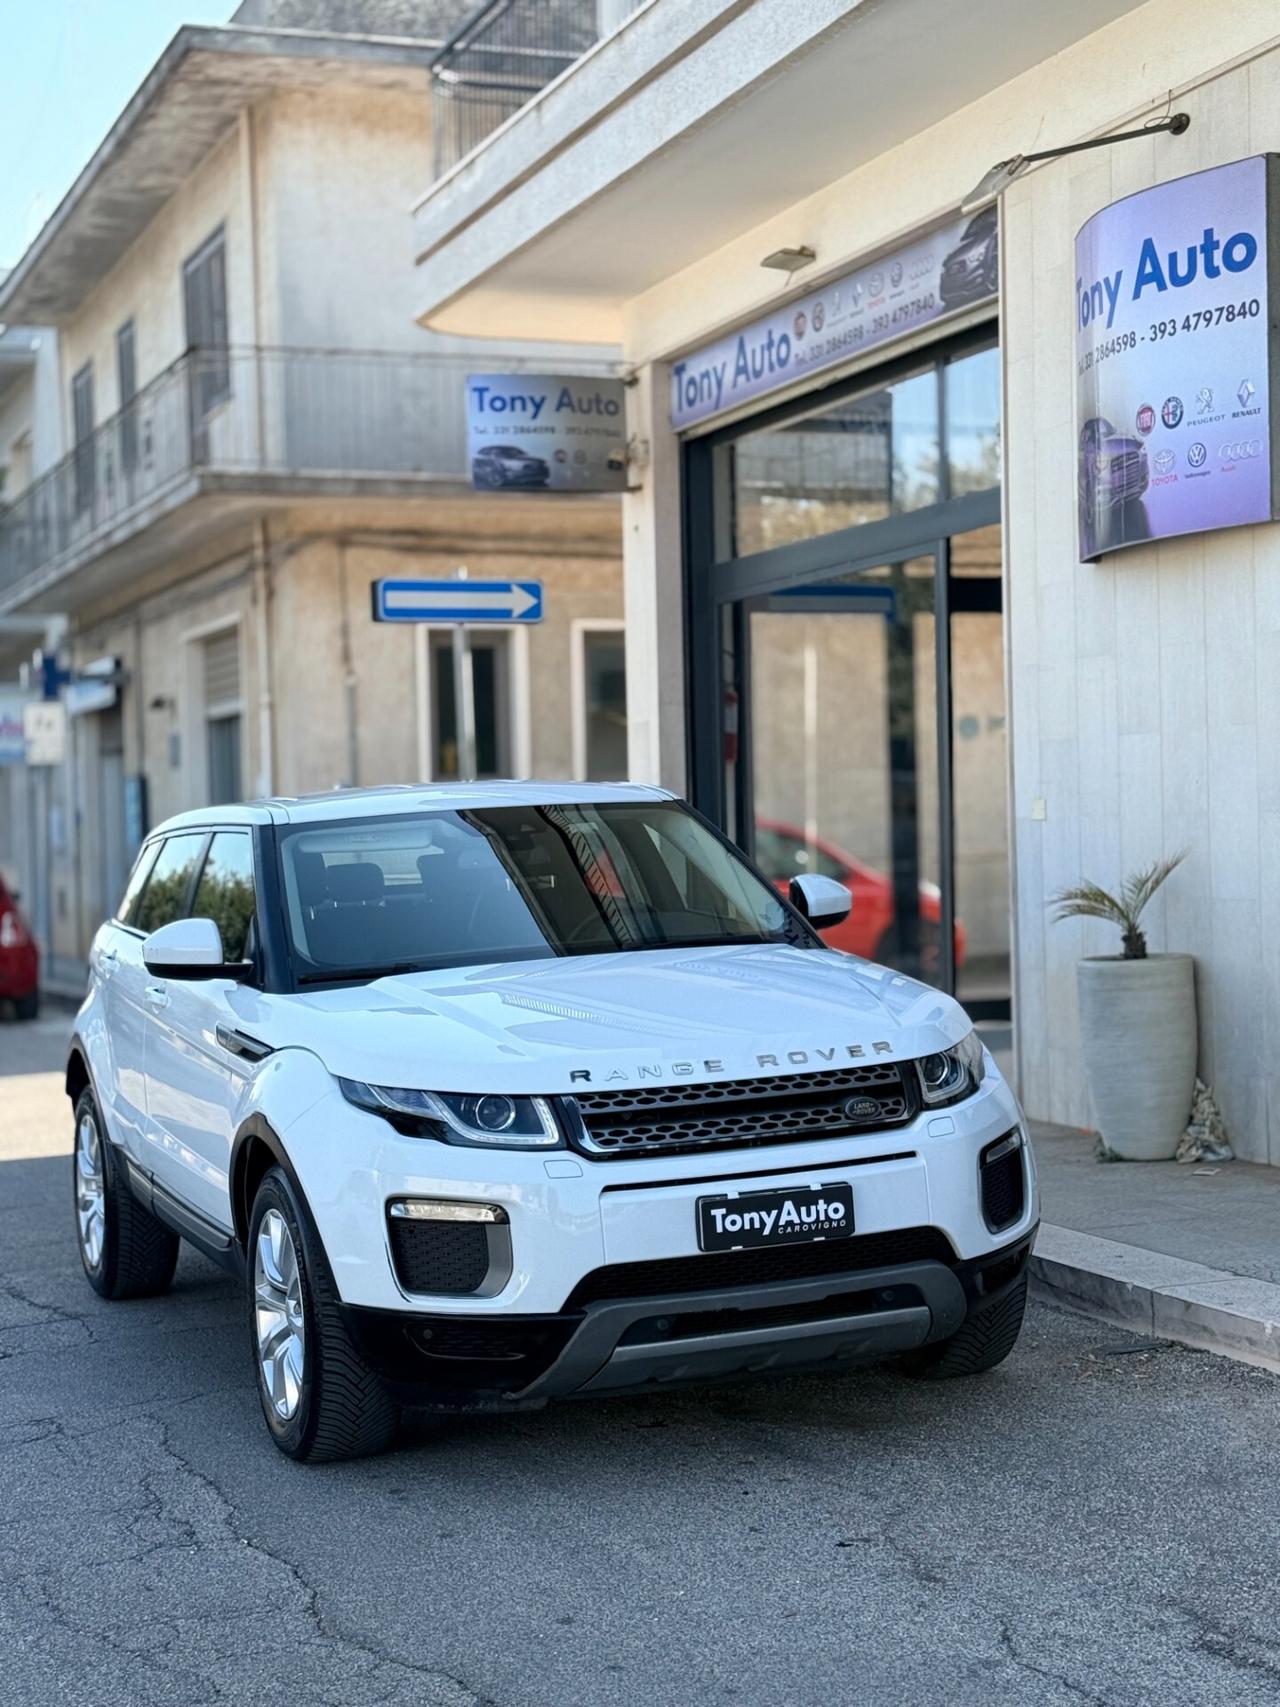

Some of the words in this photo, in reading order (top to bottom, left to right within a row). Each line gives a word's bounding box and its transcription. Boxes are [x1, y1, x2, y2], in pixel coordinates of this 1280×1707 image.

[1133, 227, 1258, 300] Auto
[871, 312, 890, 335] 393
[1095, 331, 1137, 364] 2864598
[1149, 318, 1178, 343] 393
[1181, 298, 1261, 334] 4797840
[673, 361, 726, 412] Tony
[732, 328, 791, 390] Auto
[472, 386, 547, 421] Tony
[555, 387, 620, 417] Auto
[1186, 414, 1226, 428] PEUGEOT
[1231, 407, 1262, 420] RENAULT
[1151, 474, 1179, 487] TOYOTA
[569, 1058, 725, 1084] RANGE
[755, 1040, 895, 1068] ROVER
[710, 1198, 846, 1236] TonyAuto
[777, 1219, 847, 1235] CAROVIGNO
